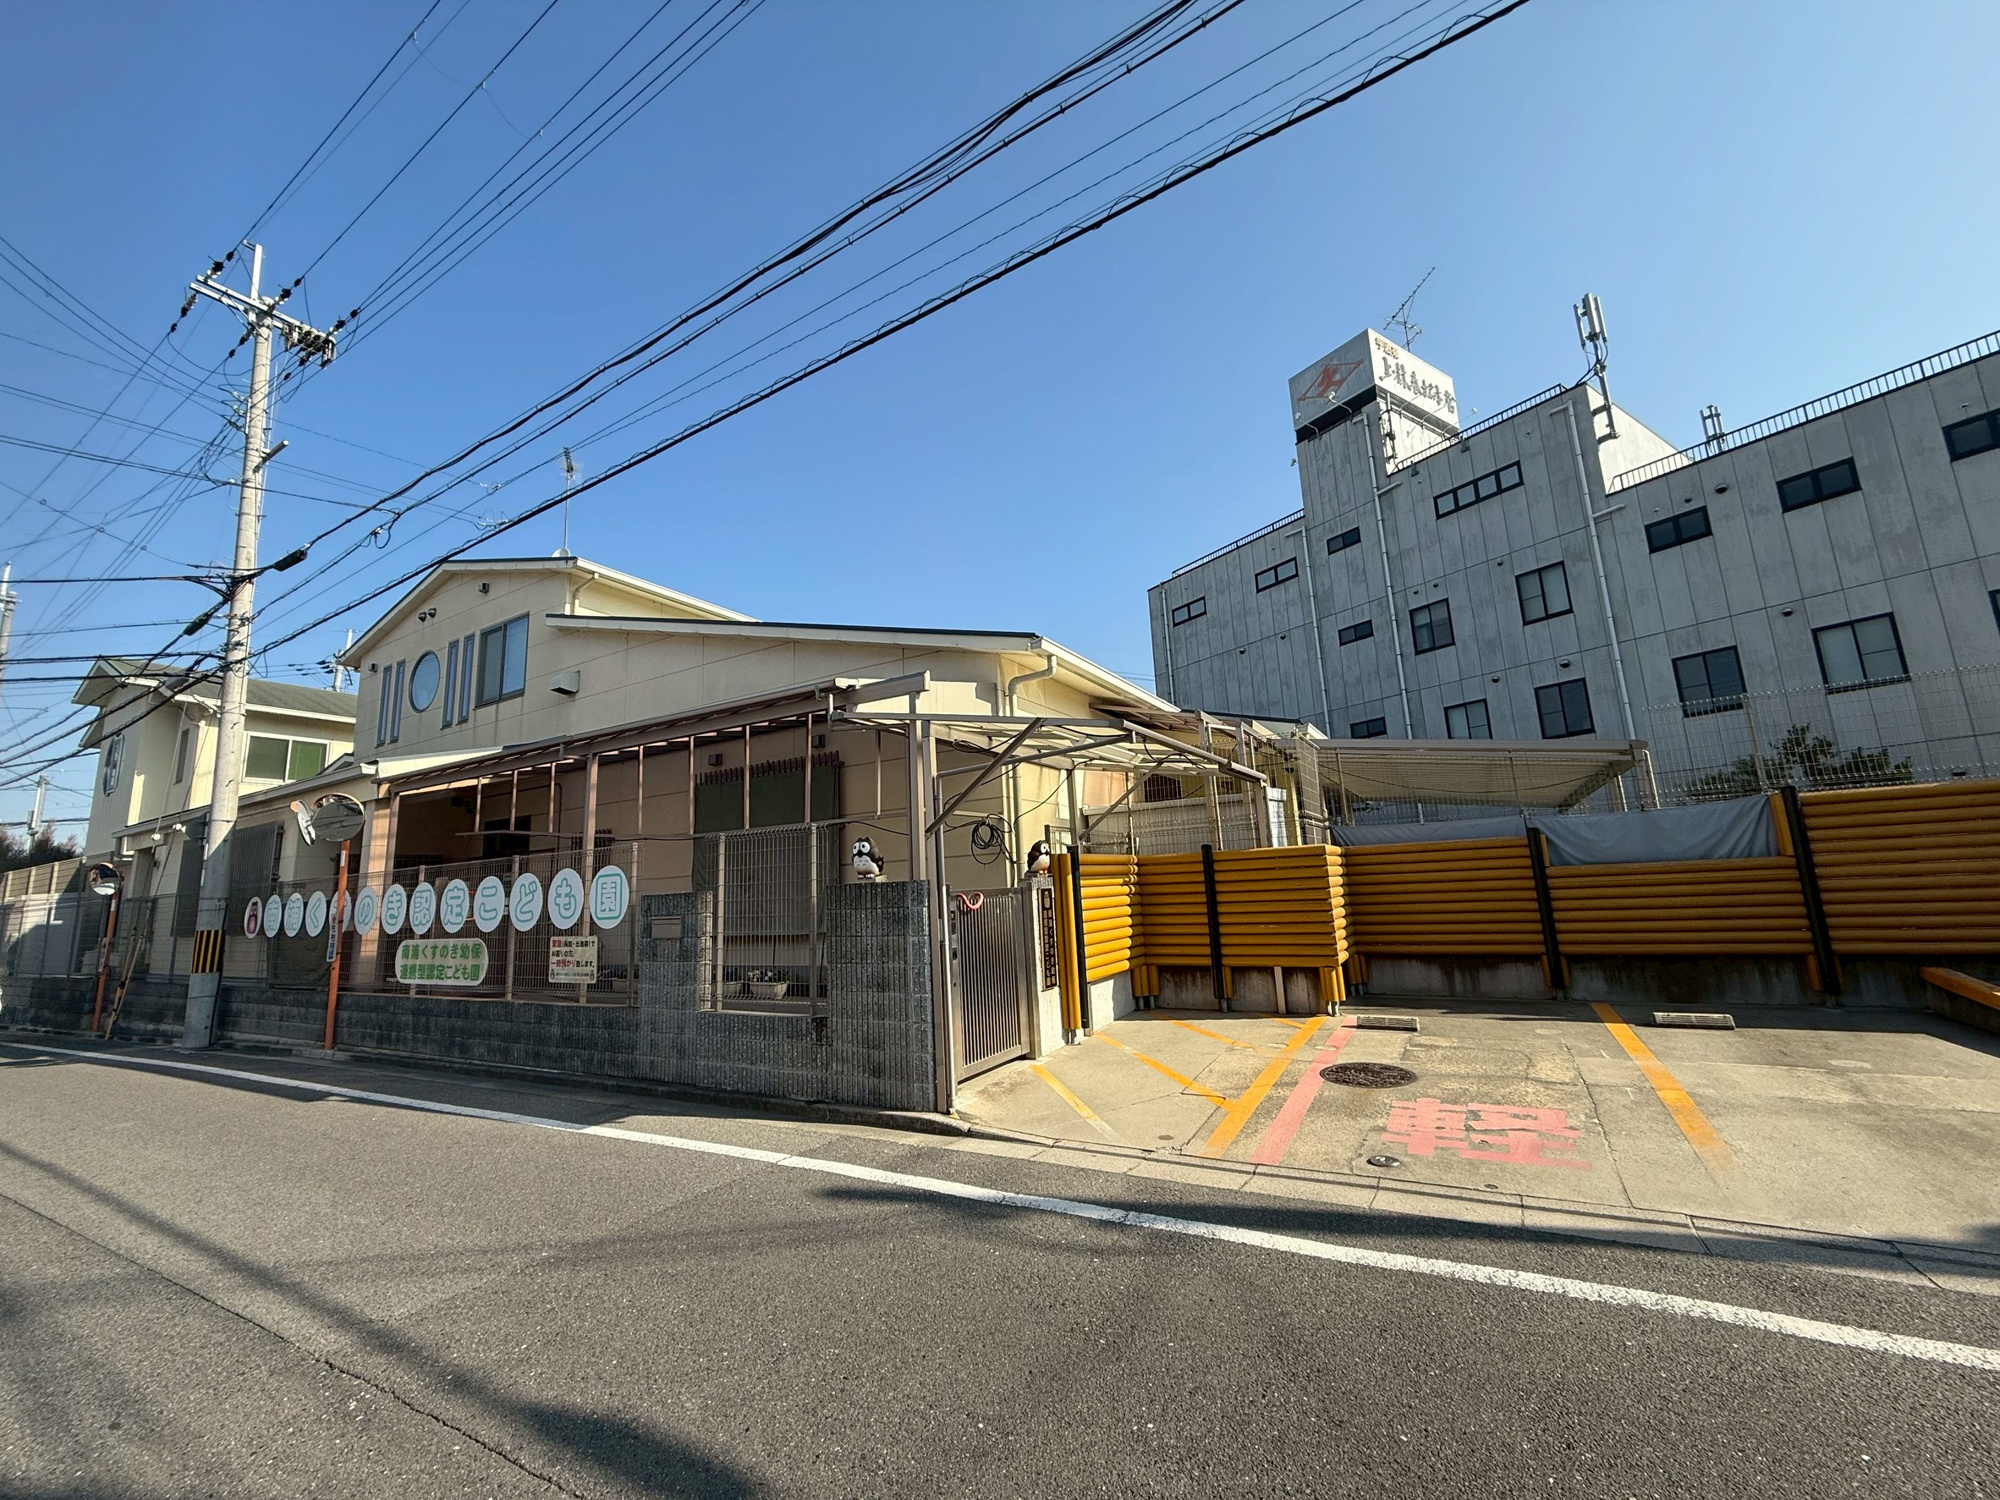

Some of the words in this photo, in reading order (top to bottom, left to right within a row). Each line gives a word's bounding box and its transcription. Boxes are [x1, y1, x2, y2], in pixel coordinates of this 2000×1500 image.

[266, 872, 622, 932] 南浦くのき認定こども園
